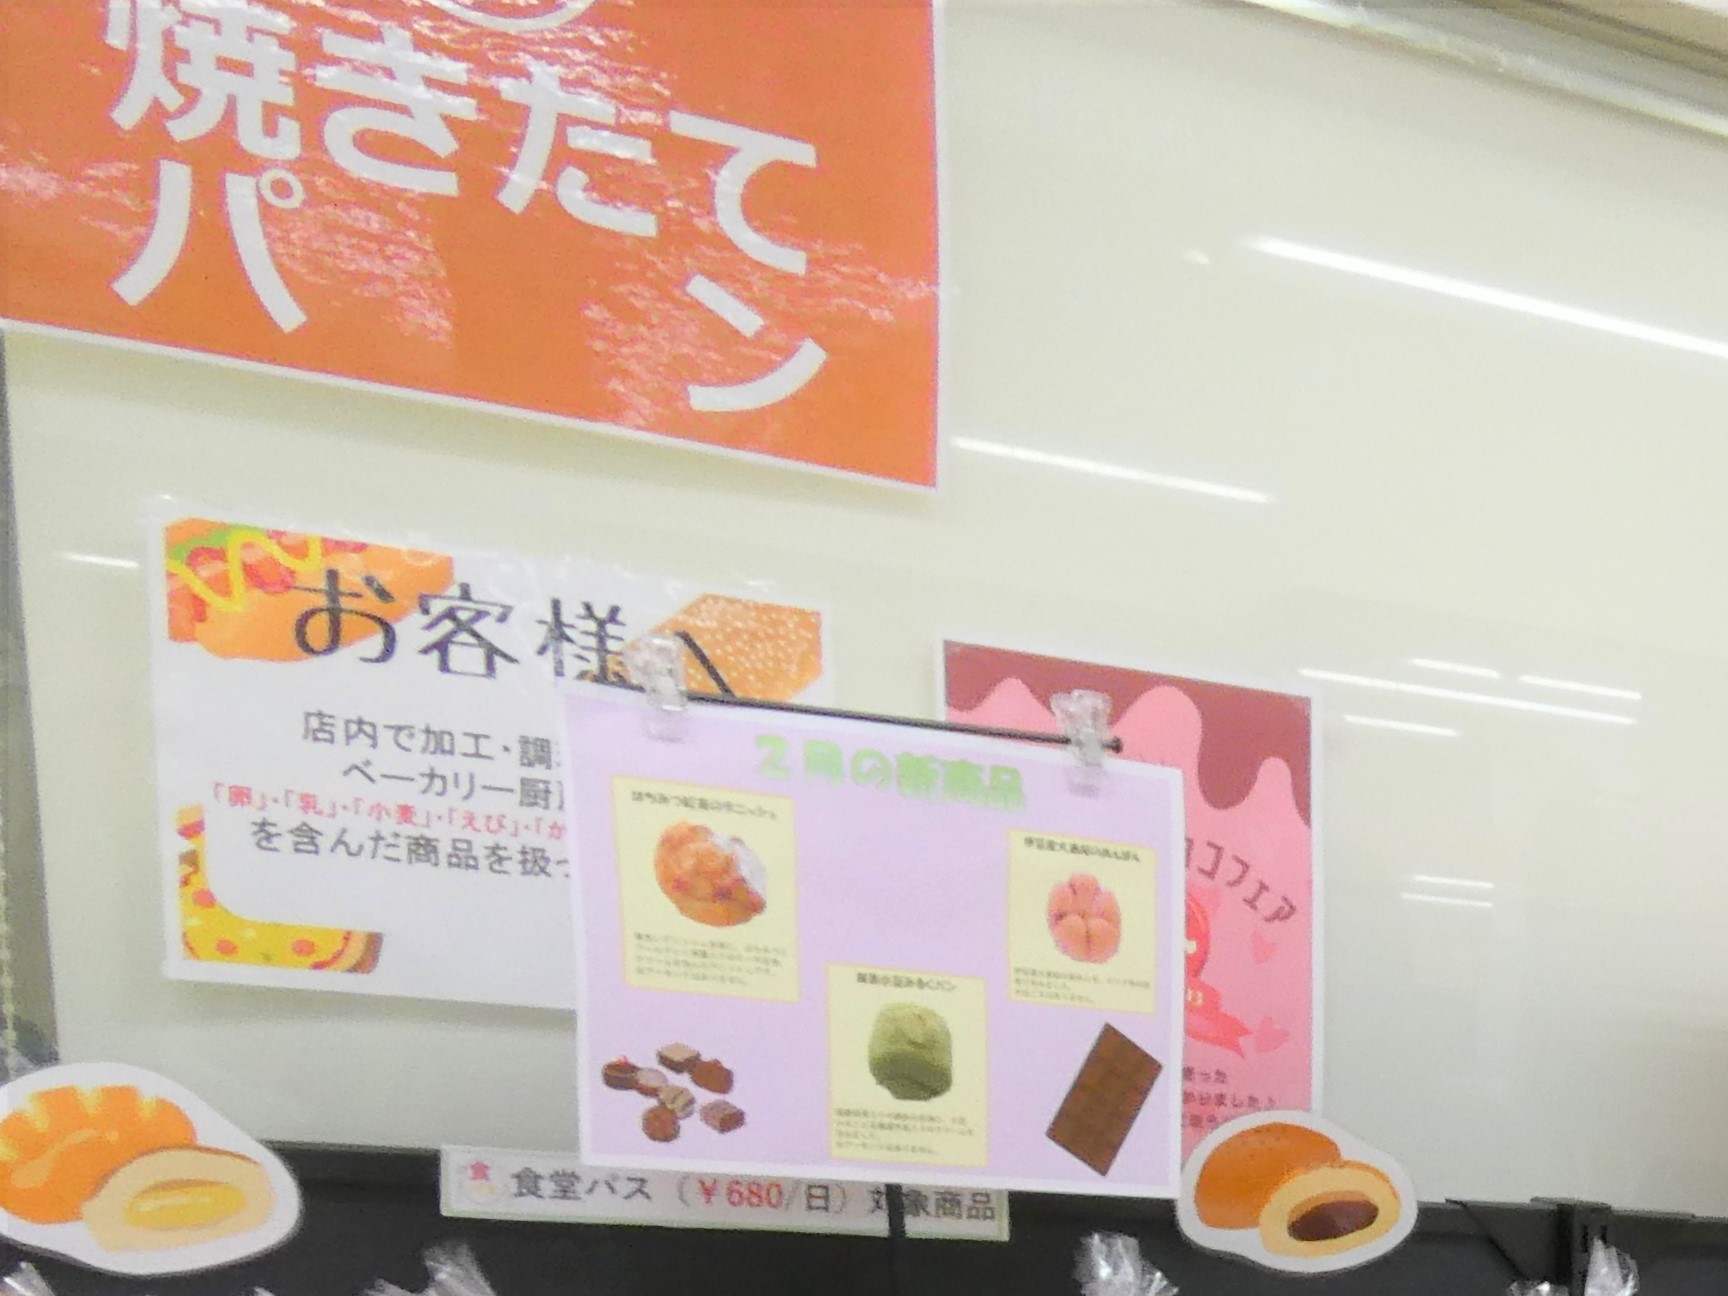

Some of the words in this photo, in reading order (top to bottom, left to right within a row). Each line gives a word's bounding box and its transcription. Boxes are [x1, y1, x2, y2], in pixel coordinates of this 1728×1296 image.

[105, 0, 818, 274] 焼きたて
[302, 709, 562, 771] 店内で加工・調
[342, 760, 566, 812] ベーカリー厨
[510, 1166, 653, 1202] 食堂パス
